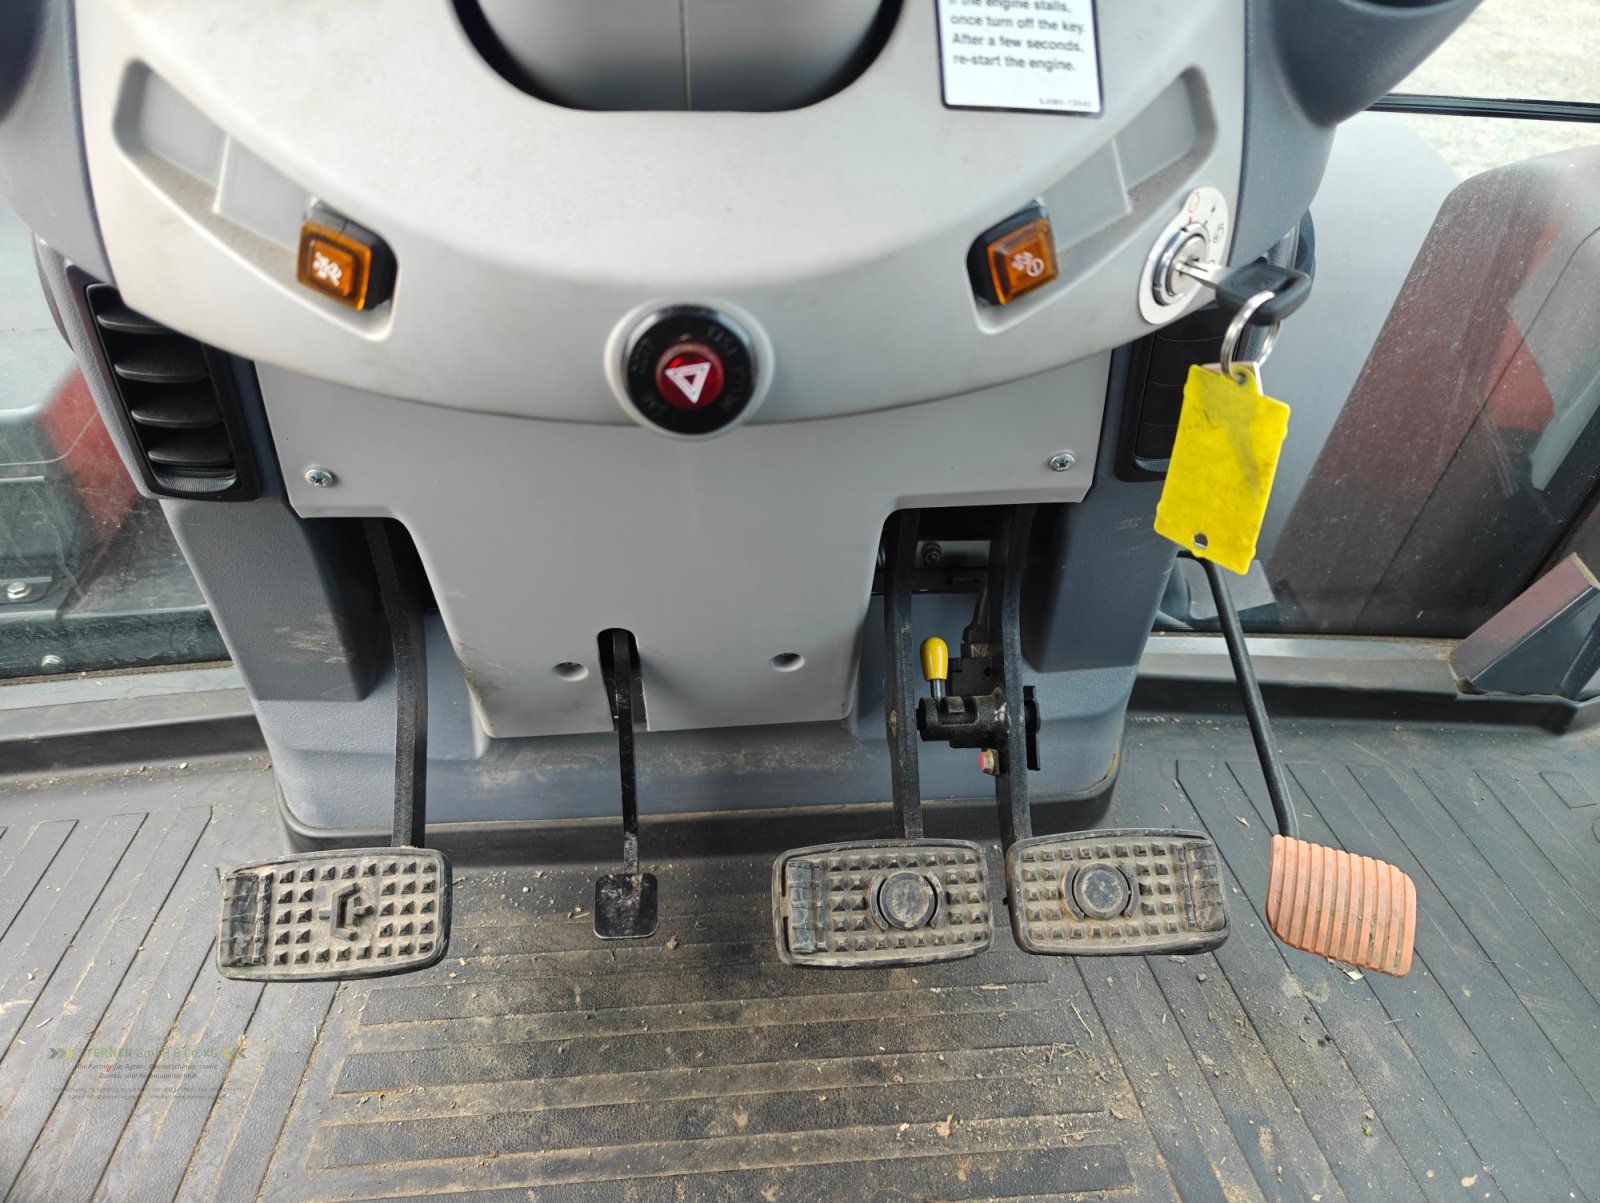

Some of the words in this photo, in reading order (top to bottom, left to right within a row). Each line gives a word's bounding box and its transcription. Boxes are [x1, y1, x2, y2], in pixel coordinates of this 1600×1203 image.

[987, 0, 1029, 10] engine
[951, 15, 982, 26] once
[986, 16, 1013, 27] turn
[1017, 18, 1034, 29] off
[1038, 19, 1058, 30] the
[953, 33, 983, 45] After
[988, 37, 995, 46] a
[1000, 36, 1022, 48] few
[953, 54, 1001, 66] re-start
[1004, 56, 1025, 68] the
[1029, 58, 1076, 72] engine.
